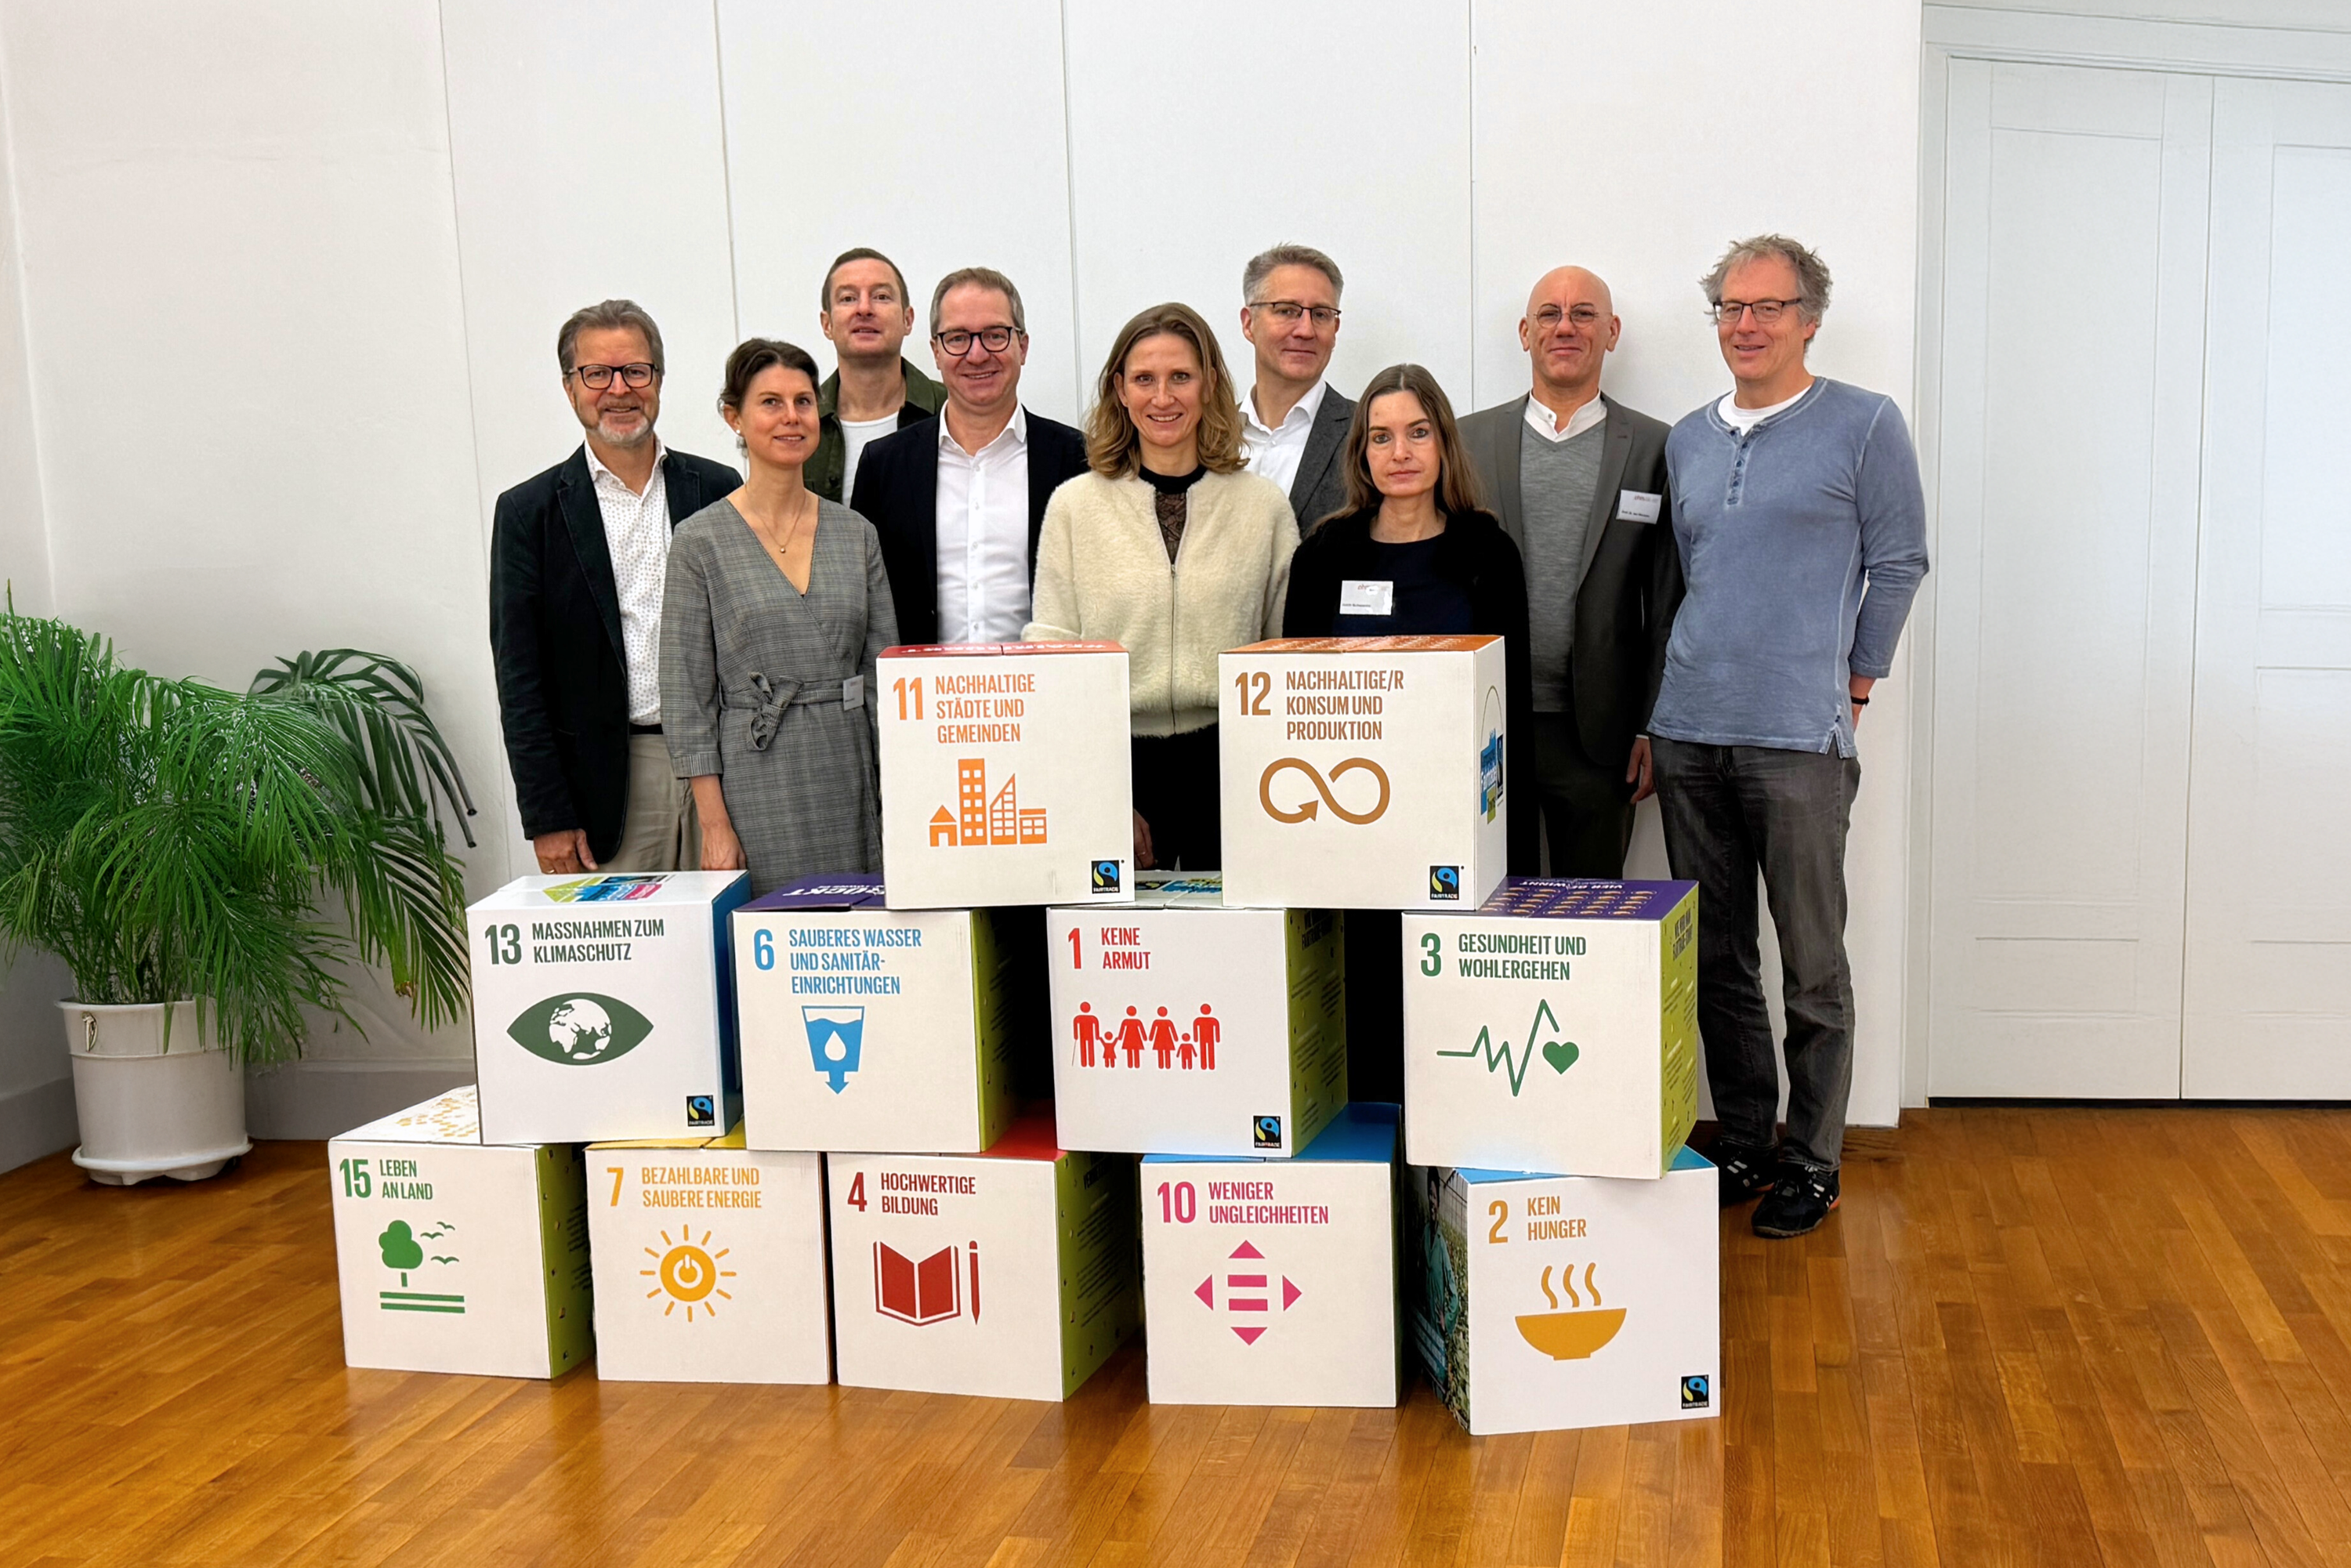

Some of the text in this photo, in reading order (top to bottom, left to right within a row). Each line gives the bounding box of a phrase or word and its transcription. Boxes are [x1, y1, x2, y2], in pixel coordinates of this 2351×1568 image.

[936, 674, 1035, 694] NACHHALTIGE
[1287, 670, 1404, 692] NACHHALTIGE/R
[893, 677, 923, 720] 11
[1235, 672, 1271, 715] 12
[936, 697, 1024, 719] STÄDTE UND
[1287, 696, 1382, 715] KONSUM UND
[937, 723, 1020, 744] GEMEINDEN
[1287, 721, 1382, 740] PRODUKTION
[532, 918, 664, 940] MASSNAHMEN ZUM
[789, 929, 922, 947] SAUBERES WASSER
[1101, 927, 1140, 946] KEINE
[485, 924, 522, 965] 13
[534, 943, 632, 963] KLIMASCHUTZ
[754, 929, 774, 970] 6
[1068, 928, 1081, 969] 1
[1421, 932, 1441, 976] 3
[1458, 933, 1586, 955] GESUNDHEIT UND
[790, 951, 885, 971] UND SANITÄR-
[1103, 951, 1150, 969] ARMUT
[1458, 958, 1570, 980] WOHLERGEHEN
[792, 976, 900, 994] EINRICHTUNGEN
[339, 1158, 371, 1198] 15
[379, 1159, 417, 1178] LEBEN
[642, 1168, 759, 1186] BEZAHLBARE UND
[382, 1182, 433, 1200] AN LAND
[607, 1167, 624, 1207] 7
[847, 1171, 868, 1212] 4
[881, 1172, 976, 1194] HOCHWERTIGE
[1208, 1182, 1273, 1200] WENIGER
[643, 1190, 761, 1208] SAUBERE ENERGIE
[882, 1196, 938, 1215] BILDUNG
[1157, 1182, 1196, 1223] 10
[1527, 1196, 1560, 1216] KEIN
[1209, 1205, 1328, 1224] UNGLEICHHEITEN
[1489, 1200, 1508, 1244] 2
[1528, 1219, 1586, 1240] HUNGER
